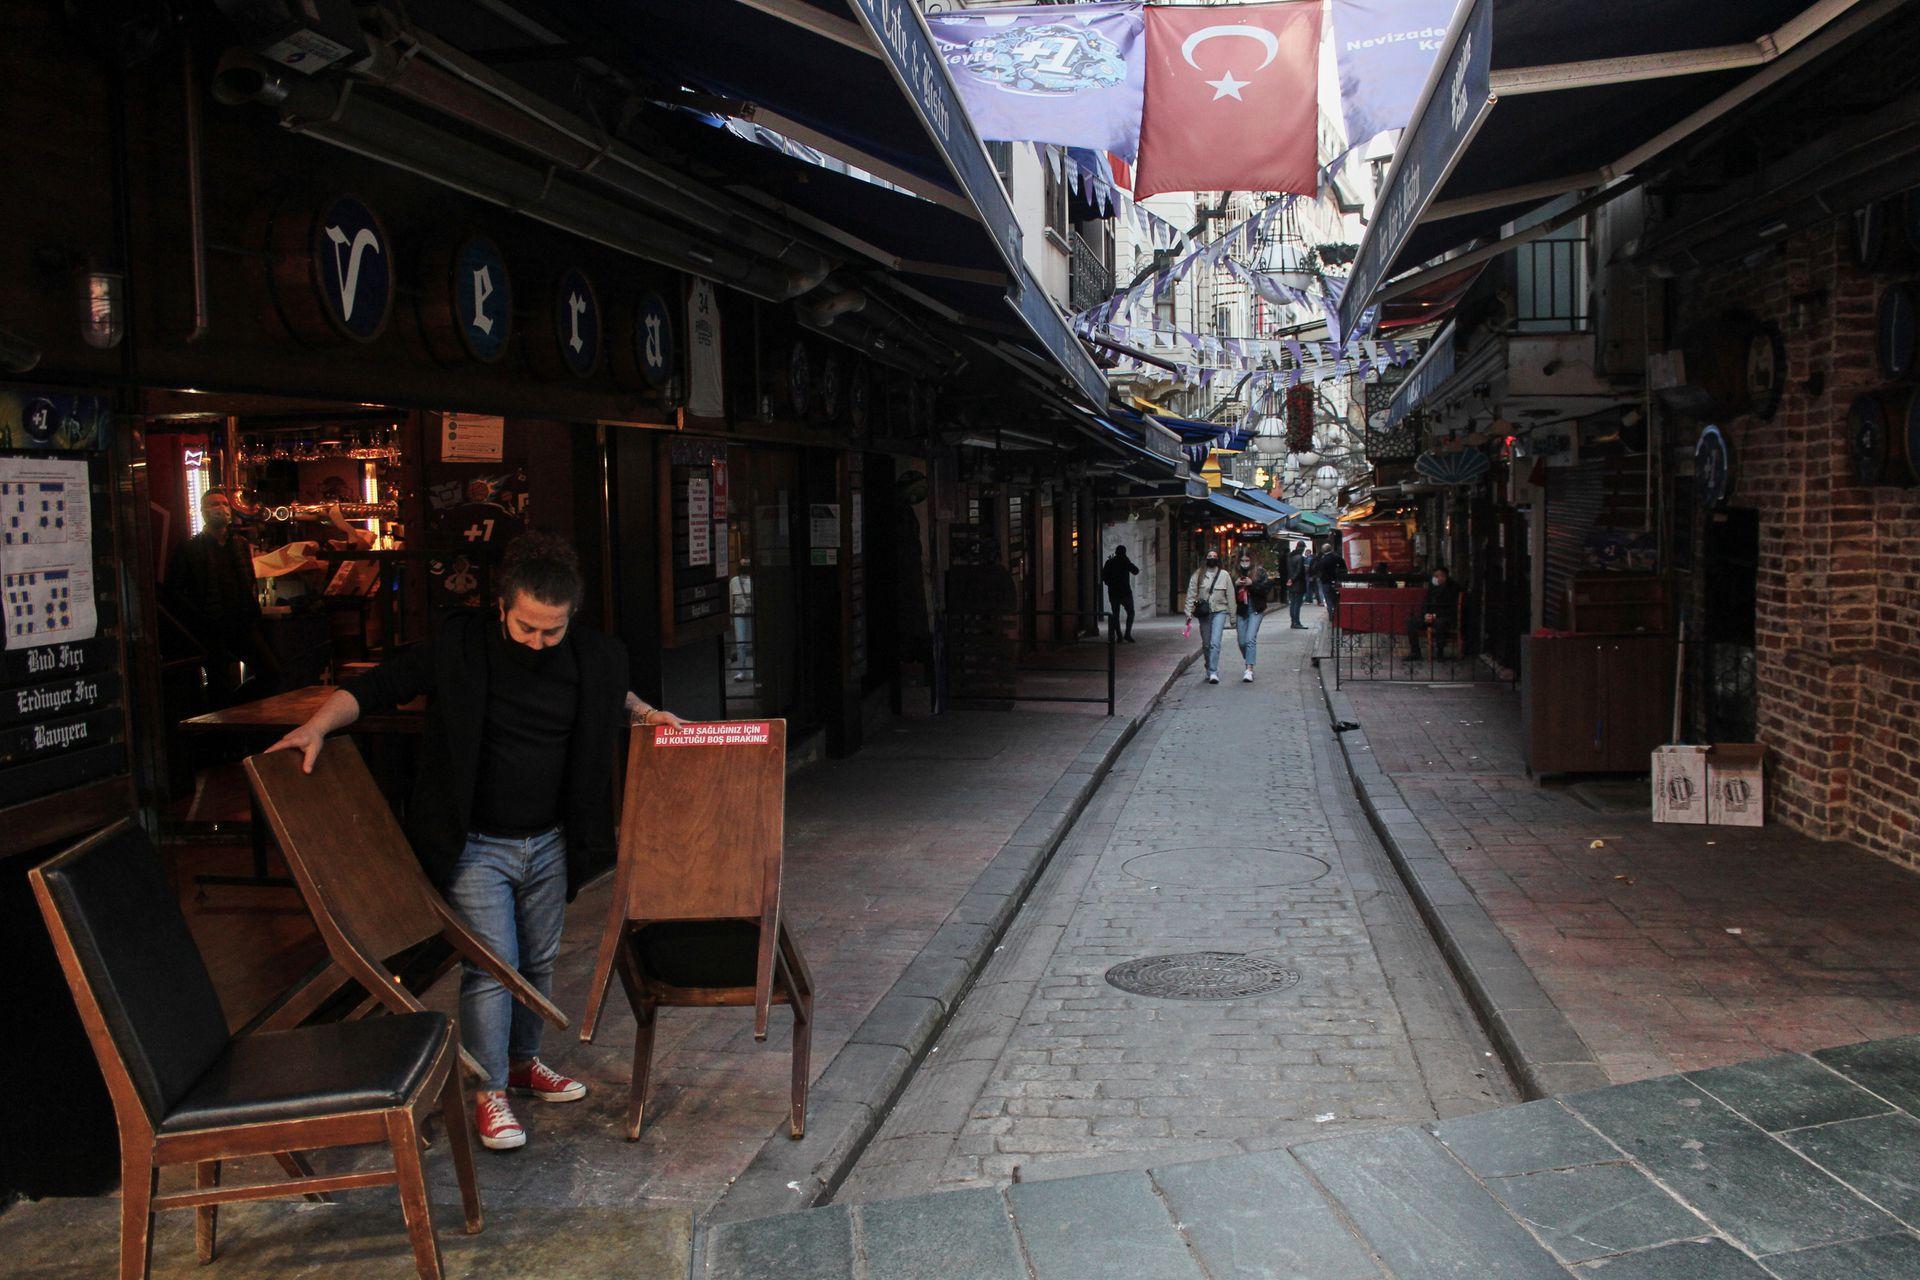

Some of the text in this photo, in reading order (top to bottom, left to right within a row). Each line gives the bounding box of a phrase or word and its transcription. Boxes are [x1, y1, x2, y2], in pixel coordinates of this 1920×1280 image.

[1013, 36, 1080, 75] +1
[31, 408, 48, 430] +1
[463, 518, 495, 543] +1
[27, 647, 56, 673] Bud
[17, 688, 72, 714] Erdinger
[33, 721, 88, 750] Bavyera
[656, 734, 769, 745] BU KOLTUĞU BOŞ BIRAKINIZ
[696, 726, 742, 735] SAĞLIĞINIZ
[743, 725, 761, 735] İÇİN
